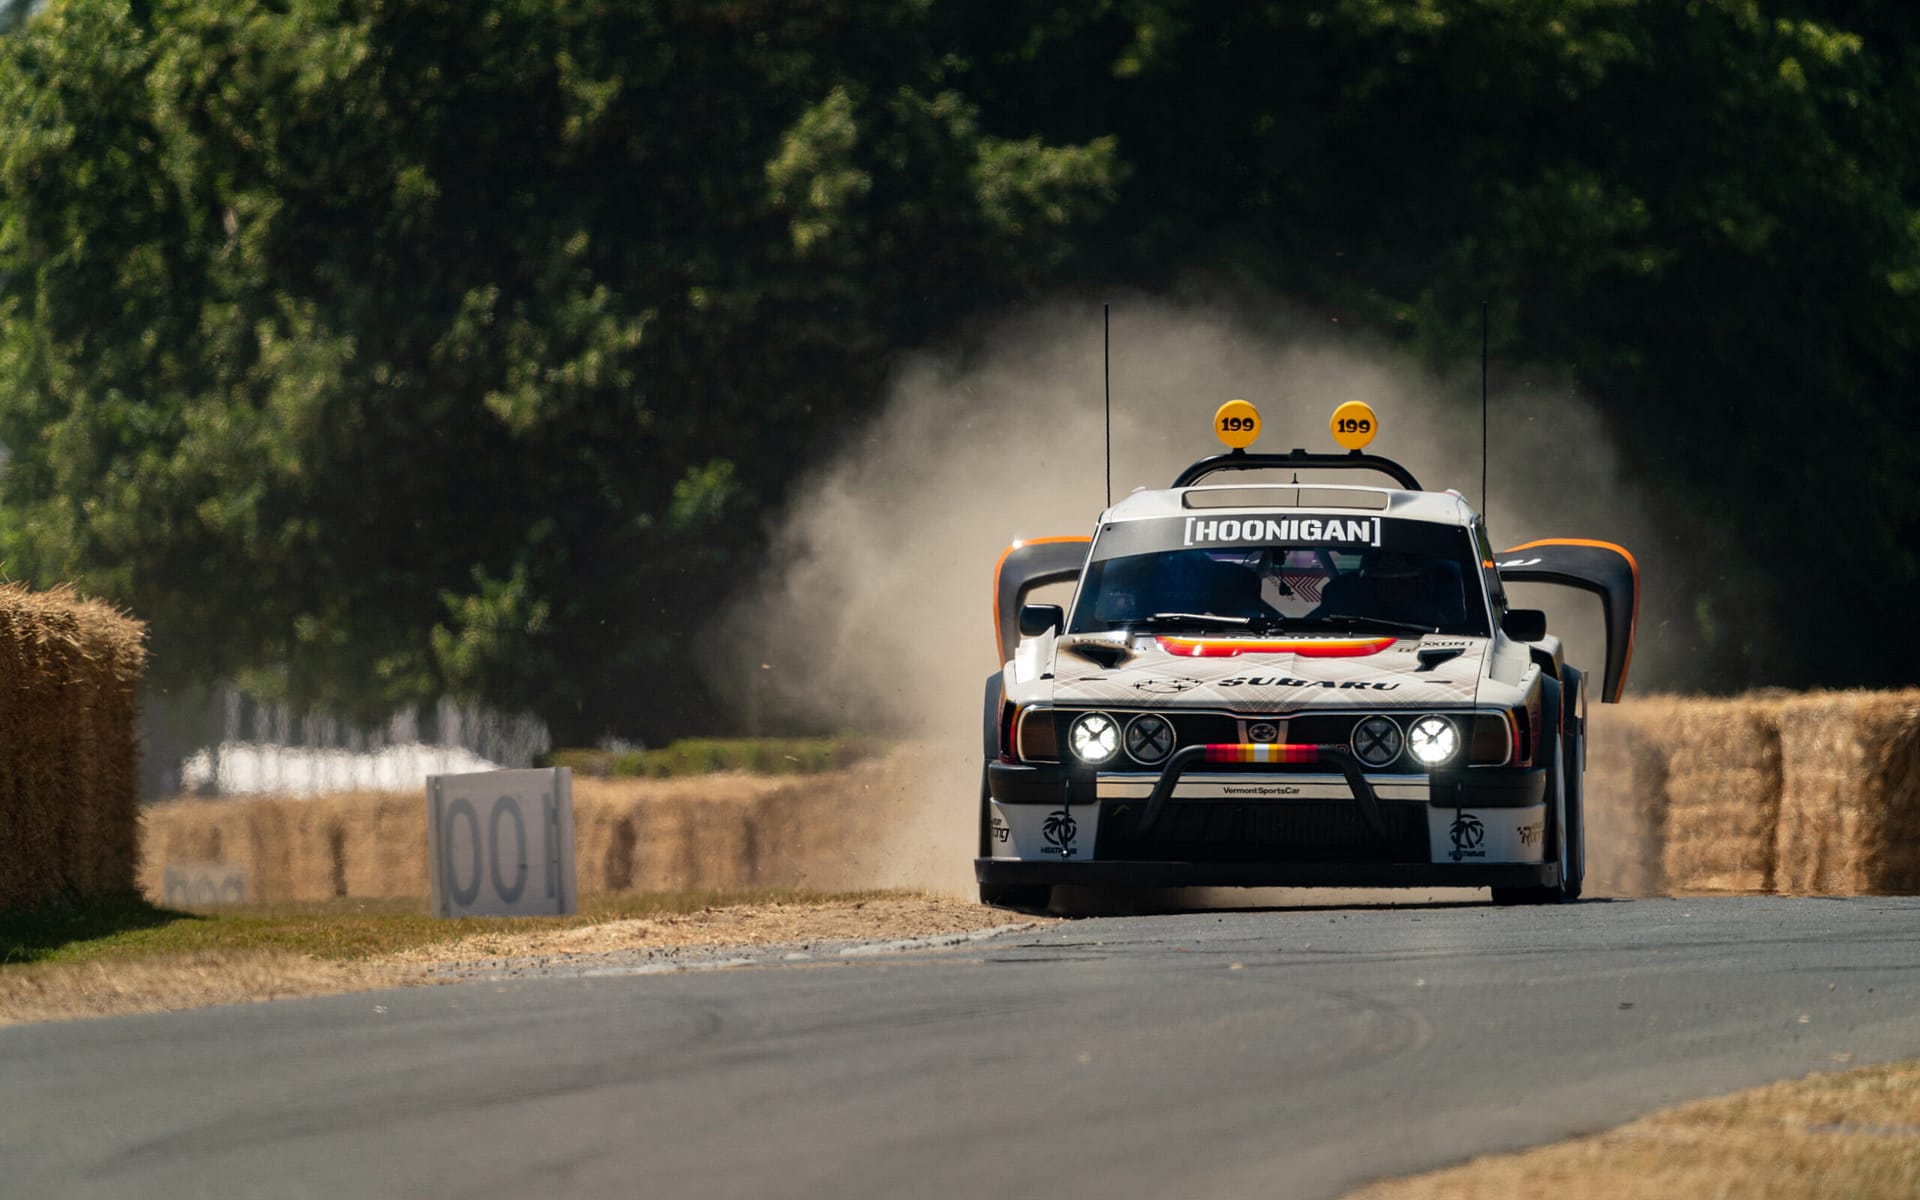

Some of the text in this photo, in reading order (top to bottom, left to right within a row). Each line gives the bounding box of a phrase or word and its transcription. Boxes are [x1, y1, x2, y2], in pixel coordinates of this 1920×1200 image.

[1221, 417, 1254, 432] 199
[1337, 418, 1371, 433] 199
[1218, 677, 1400, 691] SUBARU
[1223, 787, 1300, 795] VermontSportsCar
